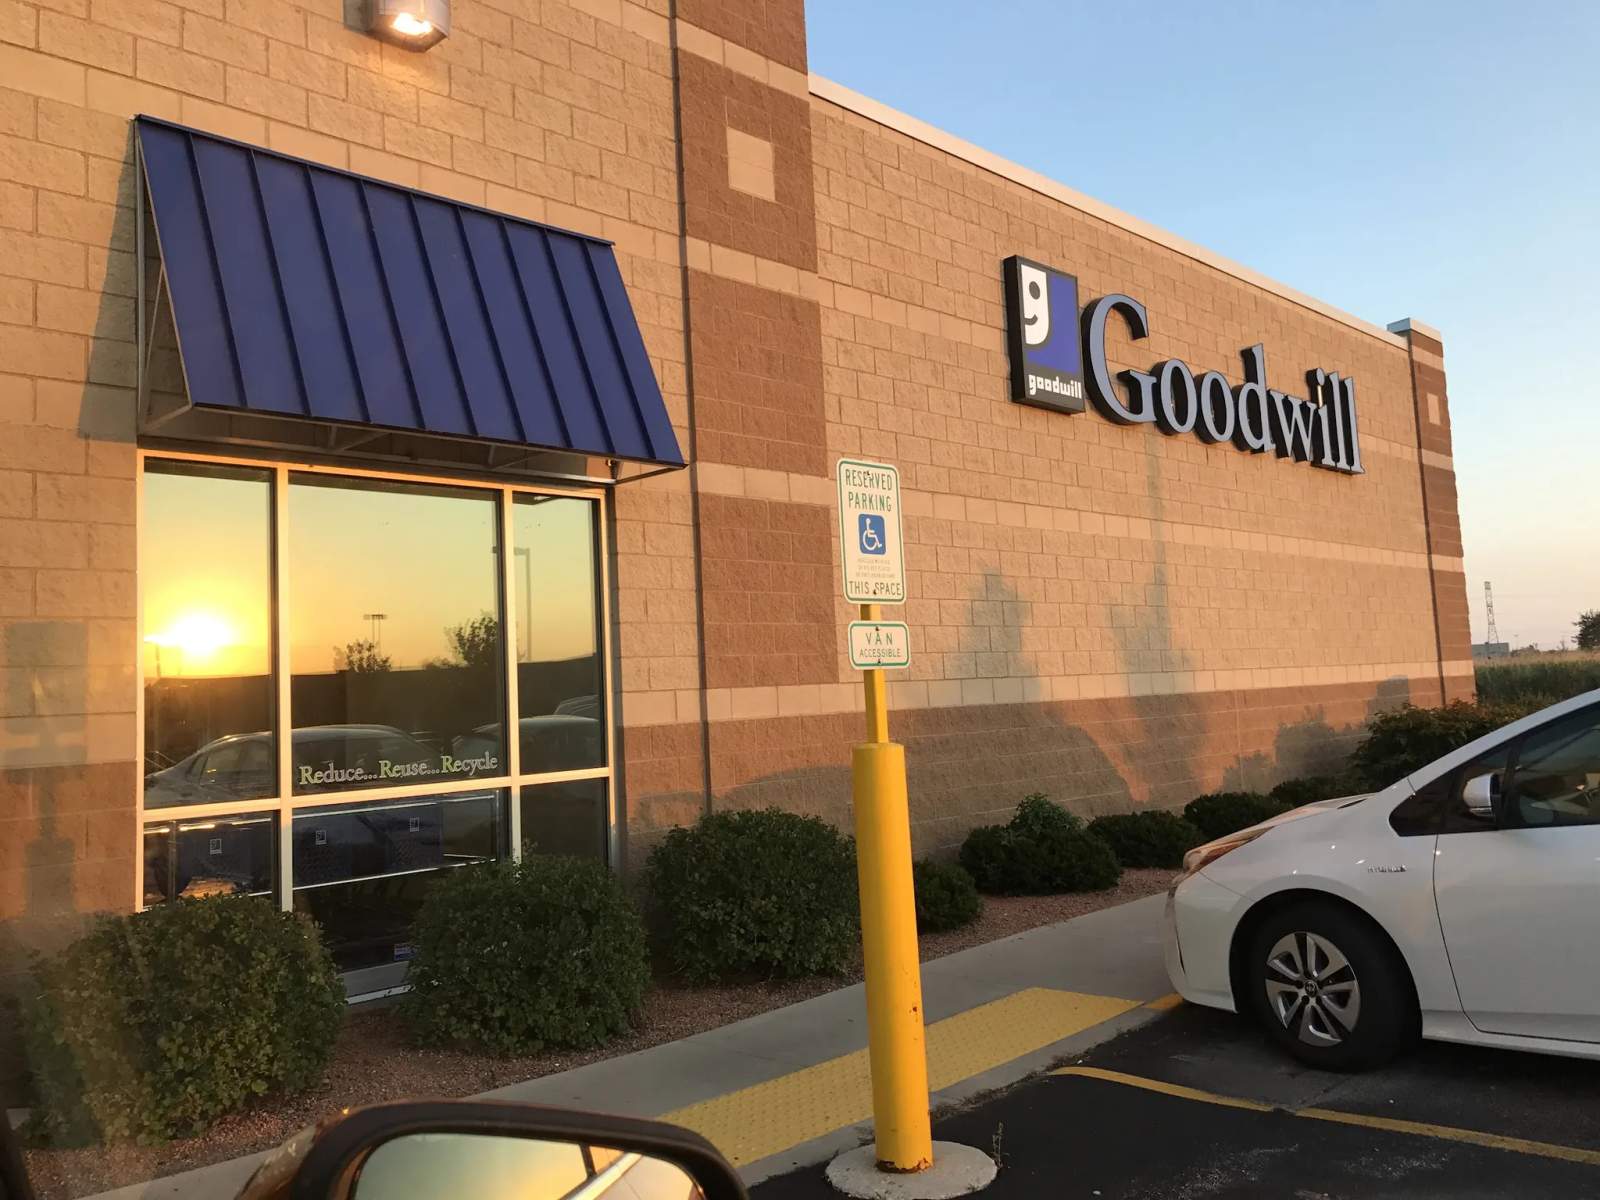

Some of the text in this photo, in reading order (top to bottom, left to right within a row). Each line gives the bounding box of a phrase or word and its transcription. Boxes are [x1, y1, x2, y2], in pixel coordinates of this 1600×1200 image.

[1028, 374, 1082, 399] goodwill
[1081, 293, 1365, 475] Goodwill
[845, 469, 893, 491] RESERVED
[848, 492, 892, 512] PARKING
[849, 581, 902, 596] THIS SPACE
[865, 632, 893, 645] VAN
[859, 648, 902, 658] ACCESSIBLE
